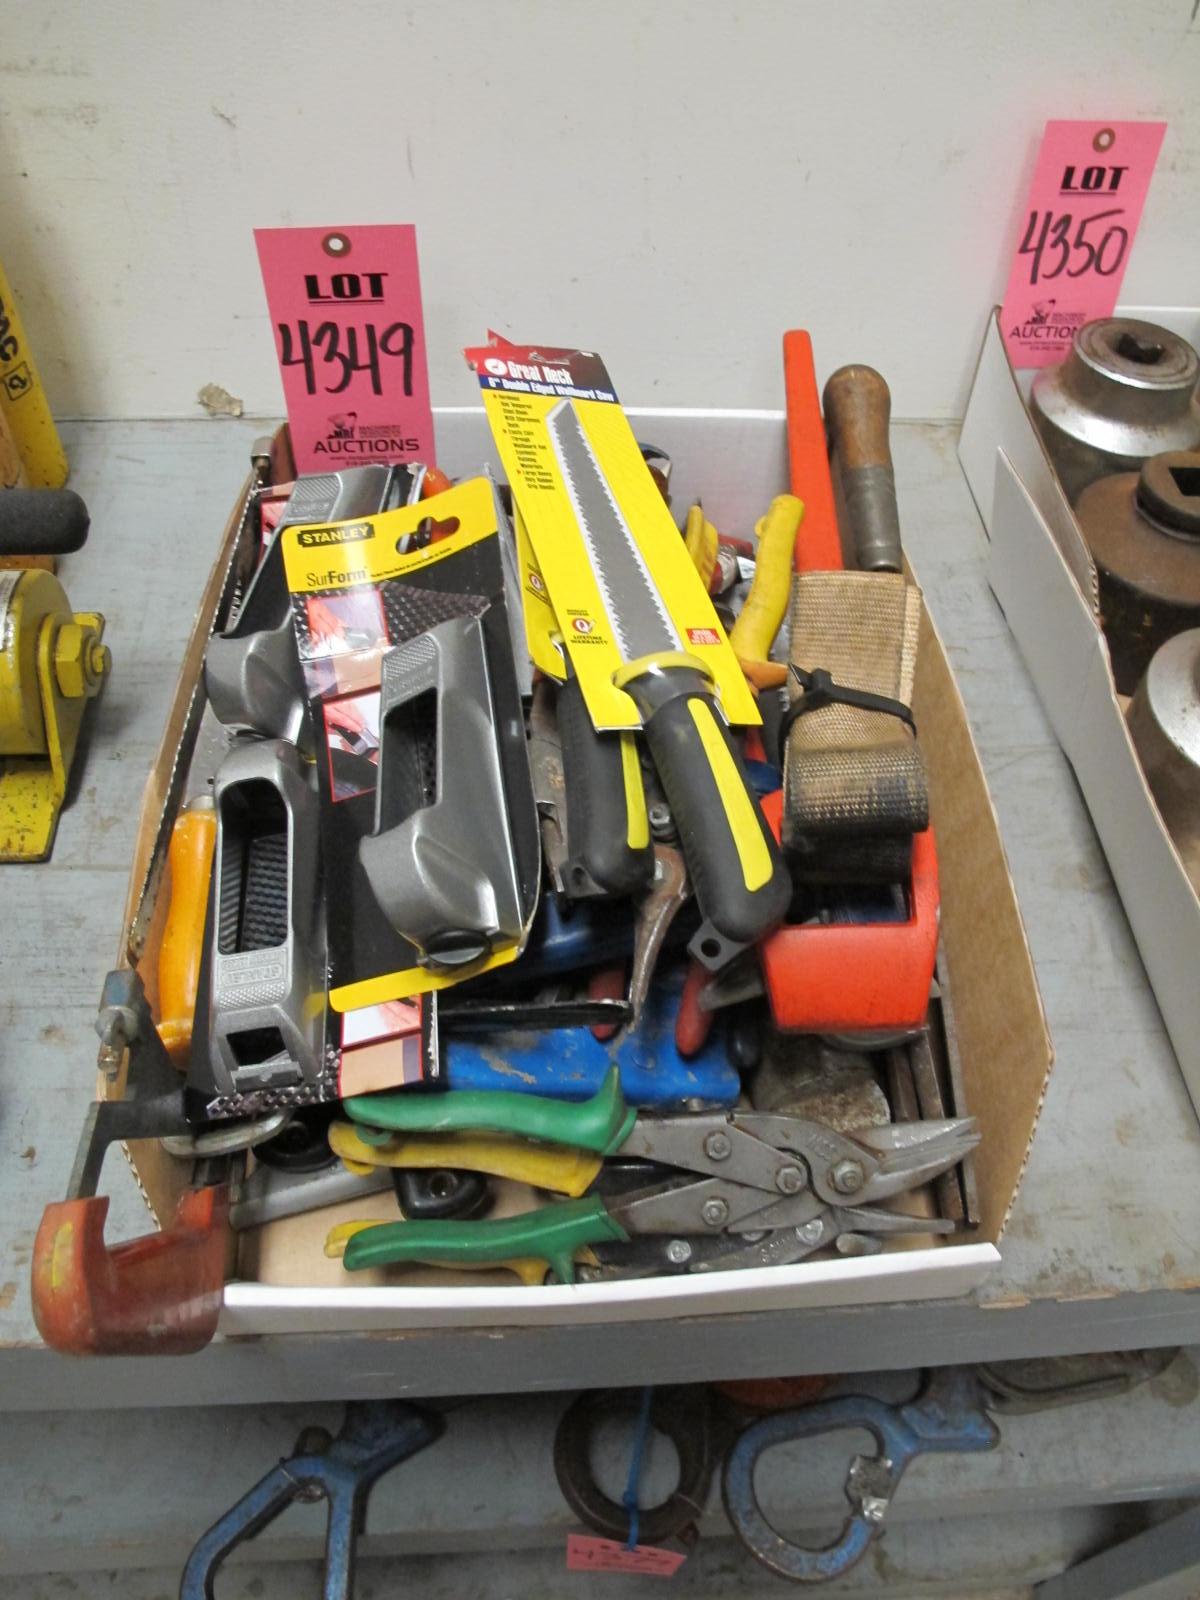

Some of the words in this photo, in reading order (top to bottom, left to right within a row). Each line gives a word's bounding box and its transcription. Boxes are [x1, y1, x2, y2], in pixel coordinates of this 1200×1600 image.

[1061, 166, 1129, 191] LOT
[1018, 209, 1128, 285] 4350
[304, 273, 388, 300] LOT
[278, 320, 415, 397] 4349
[506, 361, 543, 382] Great
[313, 438, 420, 454] AUCTIONS
[302, 526, 370, 545] STANLEY
[306, 568, 367, 587] SurForm
